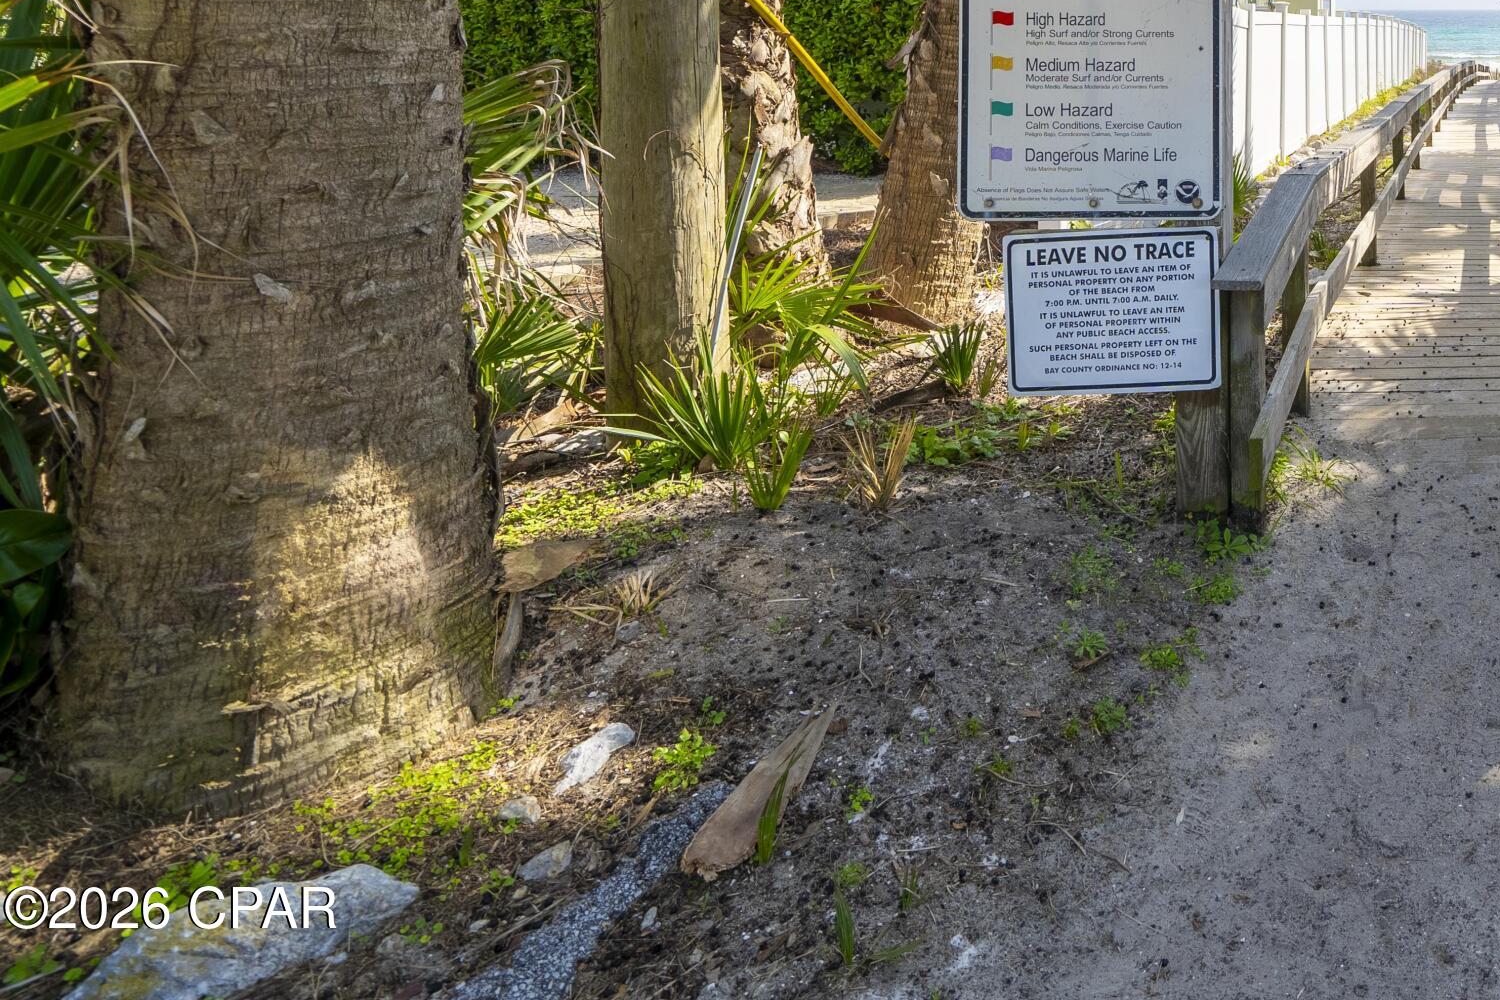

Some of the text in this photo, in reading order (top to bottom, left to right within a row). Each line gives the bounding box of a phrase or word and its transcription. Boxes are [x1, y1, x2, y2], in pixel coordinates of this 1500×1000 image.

[1026, 12, 1105, 28] High Hazard
[1026, 30, 1046, 39] High
[1071, 30, 1099, 38] and/or
[1103, 30, 1132, 39] Strong
[1025, 58, 1136, 71] Medium Hazard
[1025, 74, 1164, 82] Moderate Surf and/or Currents
[1025, 103, 1113, 117] Low Hazard
[1052, 122, 1101, 131] Conditions,
[1025, 148, 1177, 165] Dangerous Marine Life
[1026, 241, 1195, 266] LEAVE NO TRACE
[1052, 269, 1098, 278] UNLAWFUL
[1029, 280, 1072, 288] PERSONAL
[1075, 278, 1117, 286] PROPERTY
[1061, 310, 1106, 318] UNLAWFUL
[1059, 320, 1102, 329] PERSONAL
[1105, 318, 1147, 327] PROPERTY
[1138, 327, 1170, 335] ACCESS.
[1029, 345, 1052, 353] SUCH
[1055, 343, 1098, 351] PERSONAL
[1101, 341, 1142, 349] PROPERTY
[1120, 350, 1161, 359] DISPOSED
[1095, 364, 1140, 372] ORDINANCE
